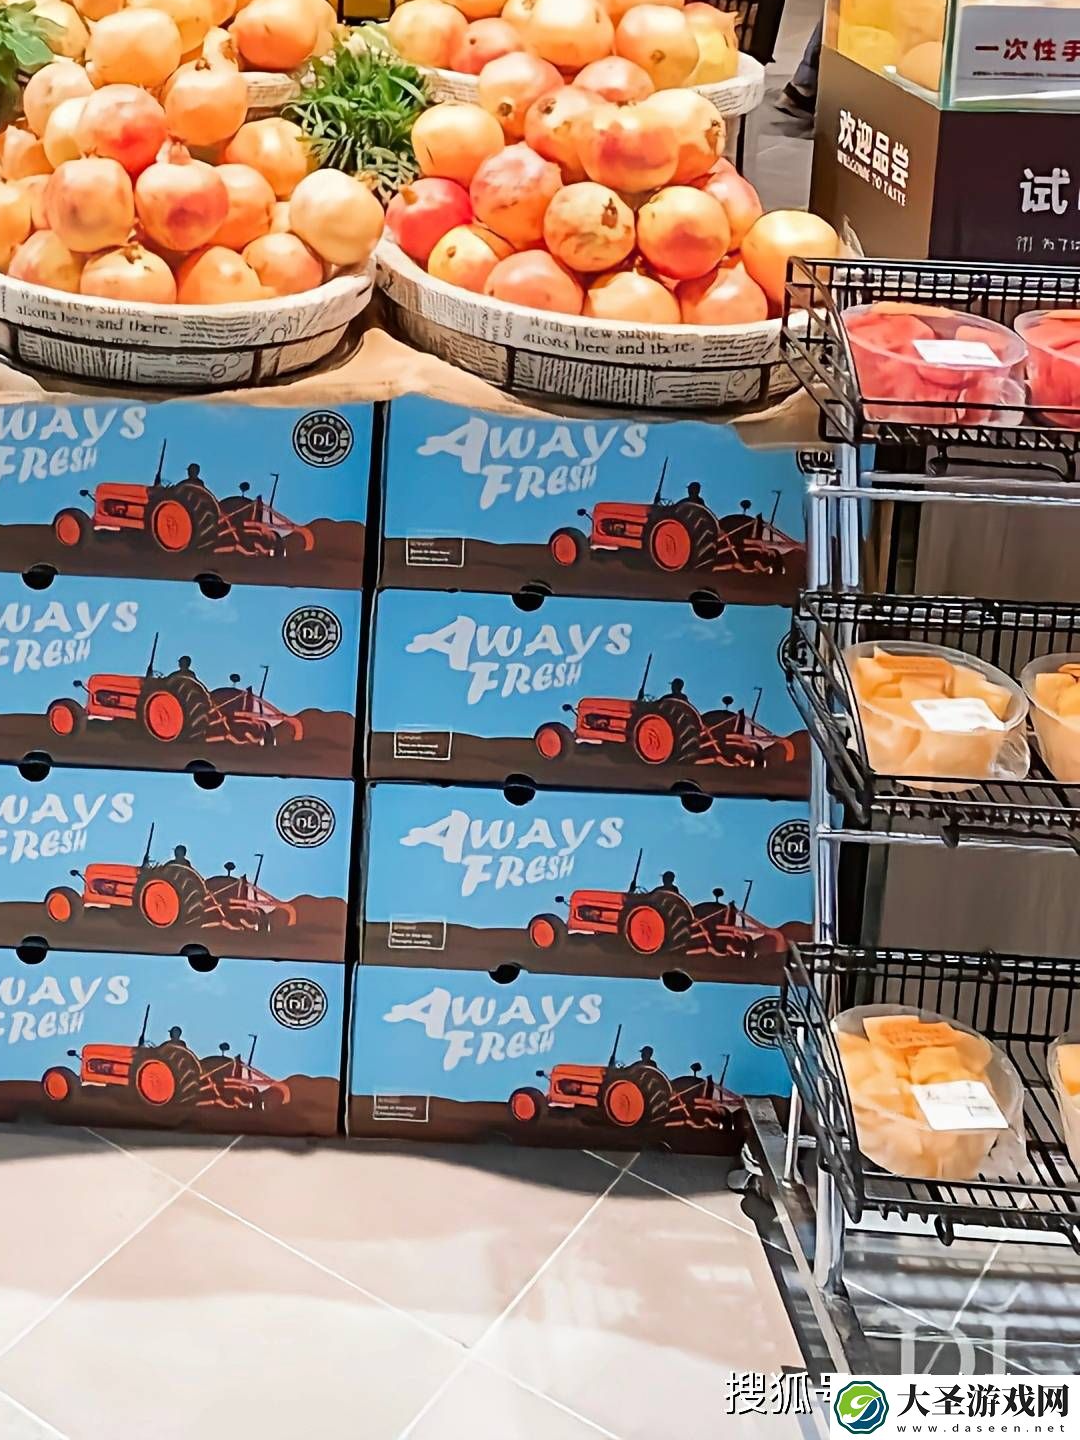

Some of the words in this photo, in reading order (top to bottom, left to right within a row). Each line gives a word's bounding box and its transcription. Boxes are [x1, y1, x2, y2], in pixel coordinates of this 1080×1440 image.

[837, 109, 910, 189] 欢迎品尝
[836, 149, 871, 183] WELCOME
[871, 173, 883, 191] TO
[882, 179, 907, 208] TASTE
[1019, 167, 1080, 215] 试
[615, 340, 646, 355] and
[477, 462, 599, 510] FRESH
[467, 661, 583, 705] FRESH
[460, 854, 575, 898] FRESH
[443, 1029, 556, 1072] FRESH
